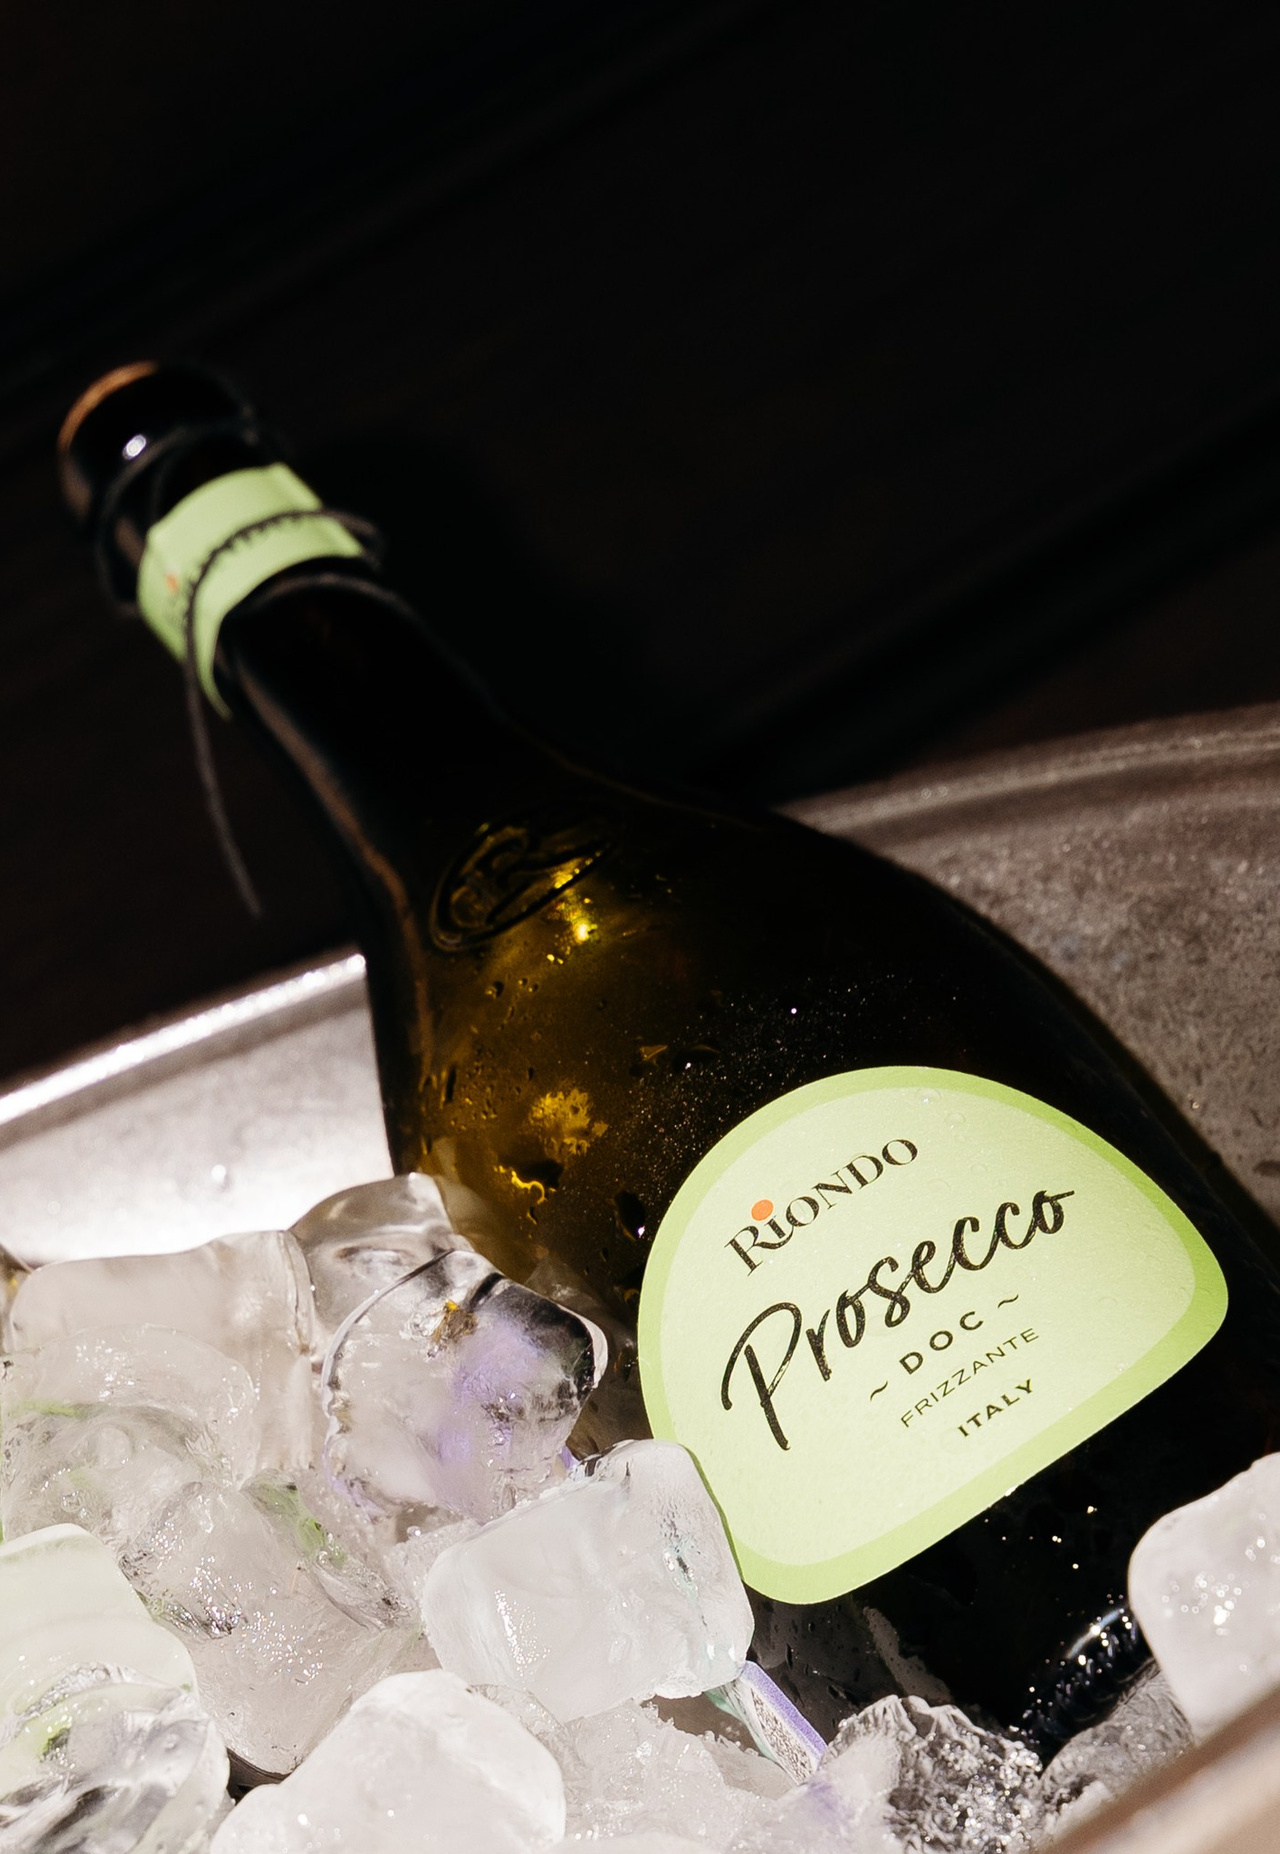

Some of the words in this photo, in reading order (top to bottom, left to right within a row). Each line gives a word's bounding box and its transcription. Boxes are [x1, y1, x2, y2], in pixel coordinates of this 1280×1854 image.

[720, 1189, 1076, 1451] Prosecco
[899, 1310, 984, 1374] DOC
[901, 1327, 1040, 1428] FRIZZANTE
[958, 1378, 1035, 1438] ITALY
